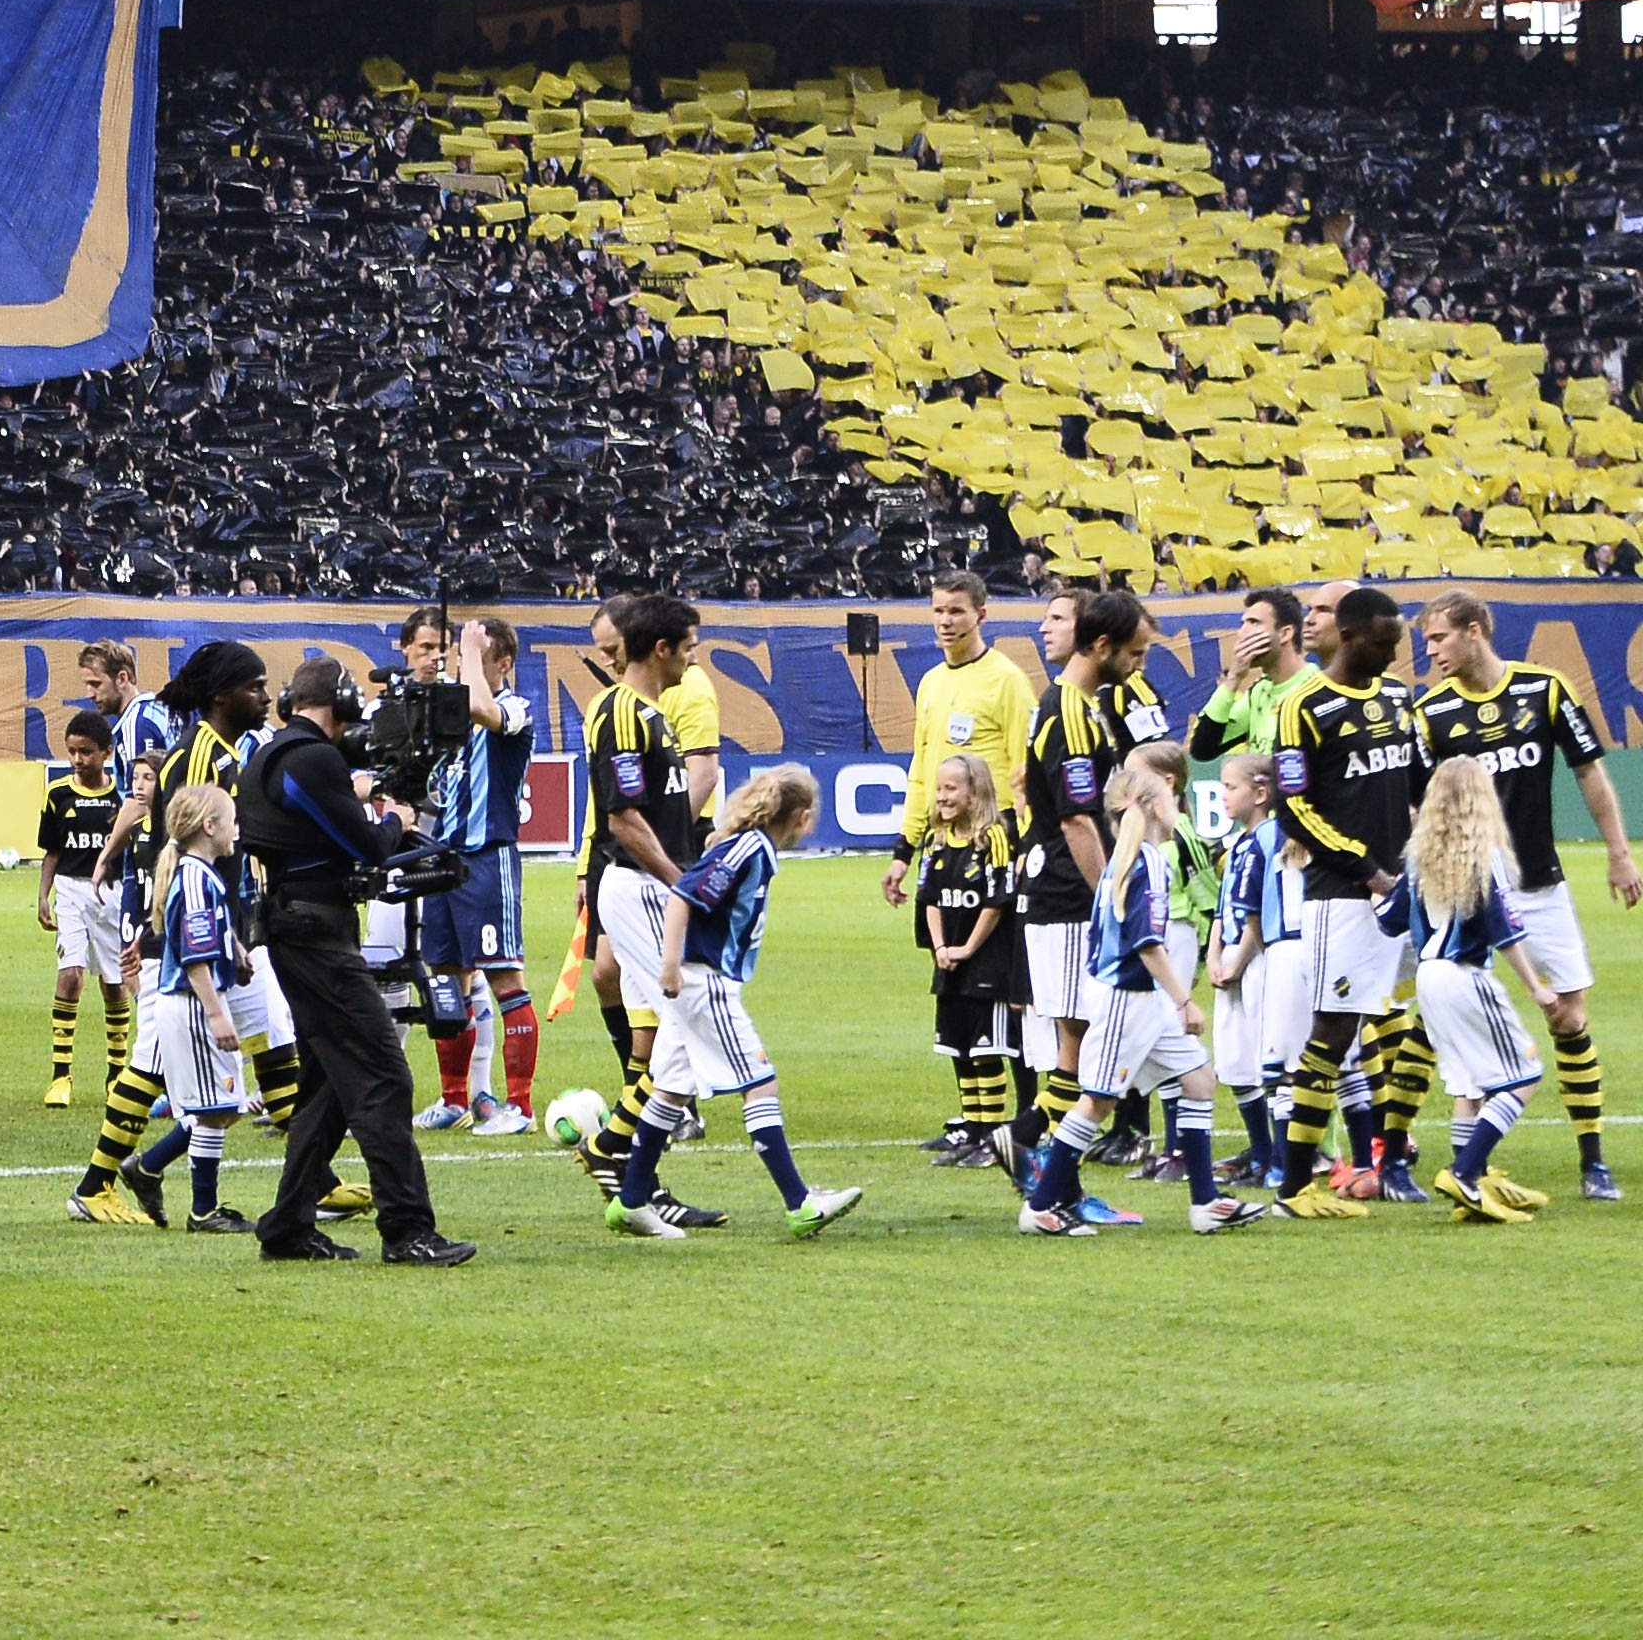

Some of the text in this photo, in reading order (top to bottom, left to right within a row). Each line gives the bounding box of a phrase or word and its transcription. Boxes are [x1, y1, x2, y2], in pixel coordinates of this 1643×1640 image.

[1474, 742, 1542, 777] BRO
[937, 888, 980, 909] BRO
[481, 924, 499, 956] 8
